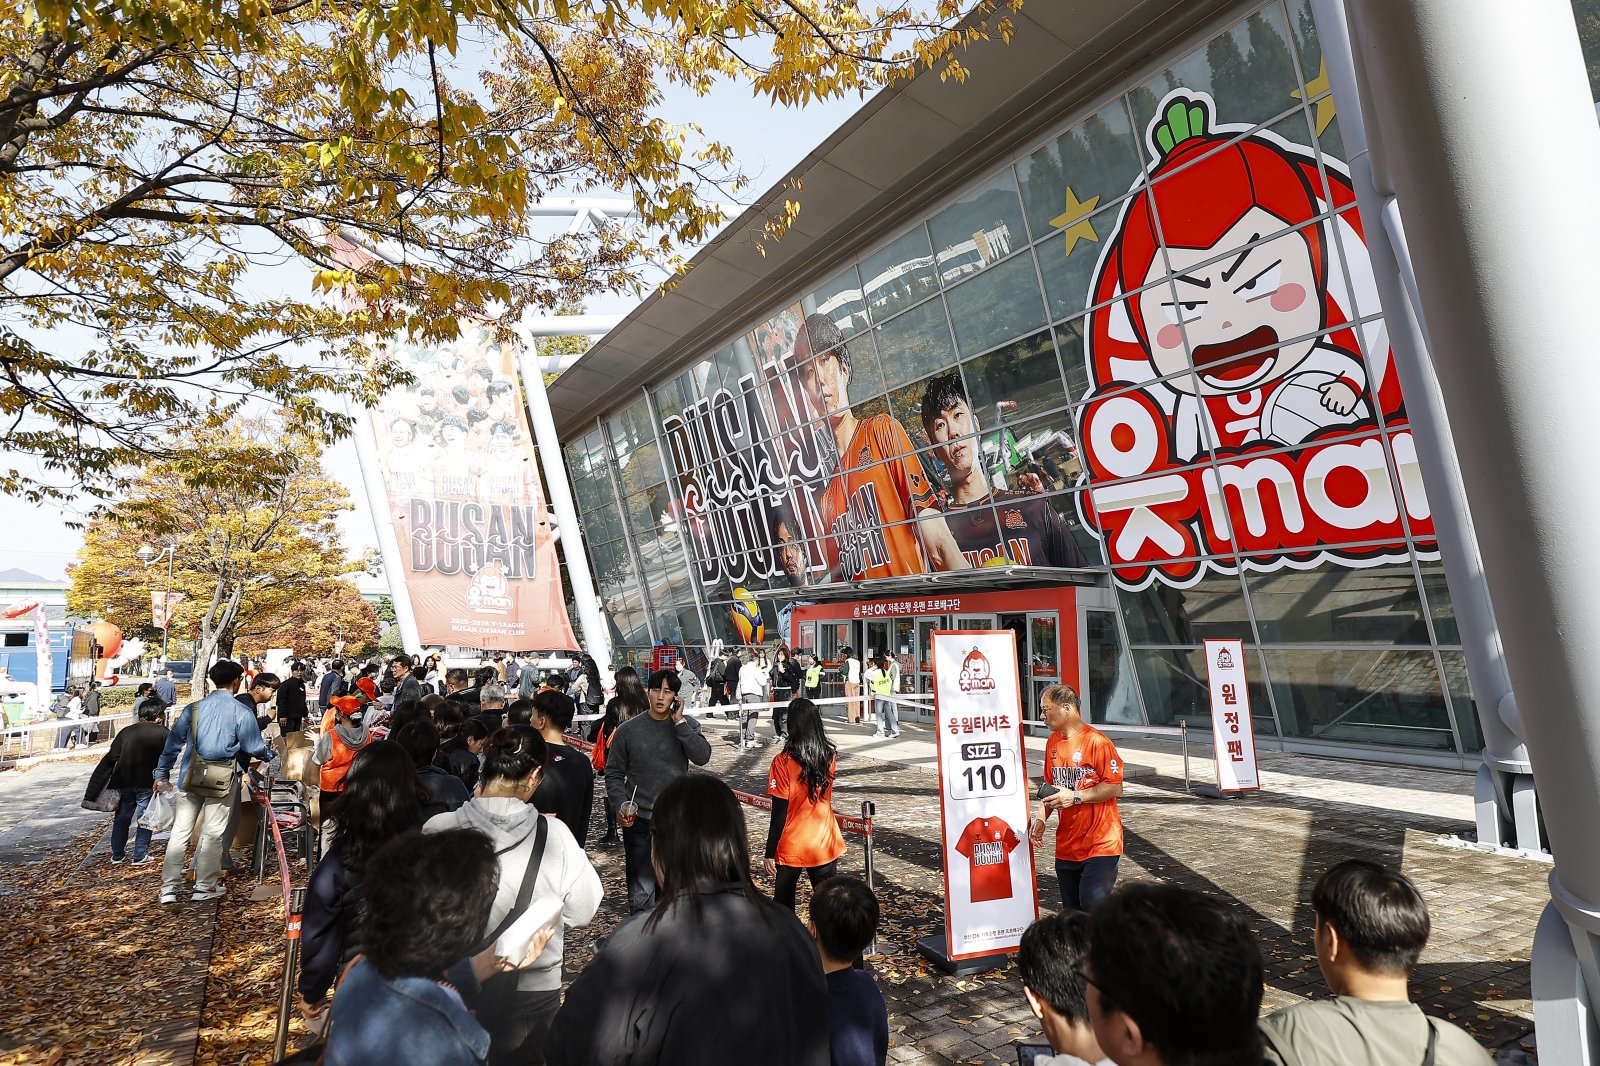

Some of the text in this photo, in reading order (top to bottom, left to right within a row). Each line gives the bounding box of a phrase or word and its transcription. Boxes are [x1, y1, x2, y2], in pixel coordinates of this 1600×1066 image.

[861, 605, 874, 616] 부산
[874, 603, 887, 615] OK
[888, 602, 911, 613] 저축은행
[927, 599, 961, 611] 프로배구단
[451, 625, 478, 633] BUSAN
[948, 714, 1011, 735] 응원티셔츠
[967, 744, 996, 759] SIZE
[963, 764, 1006, 791] 110
